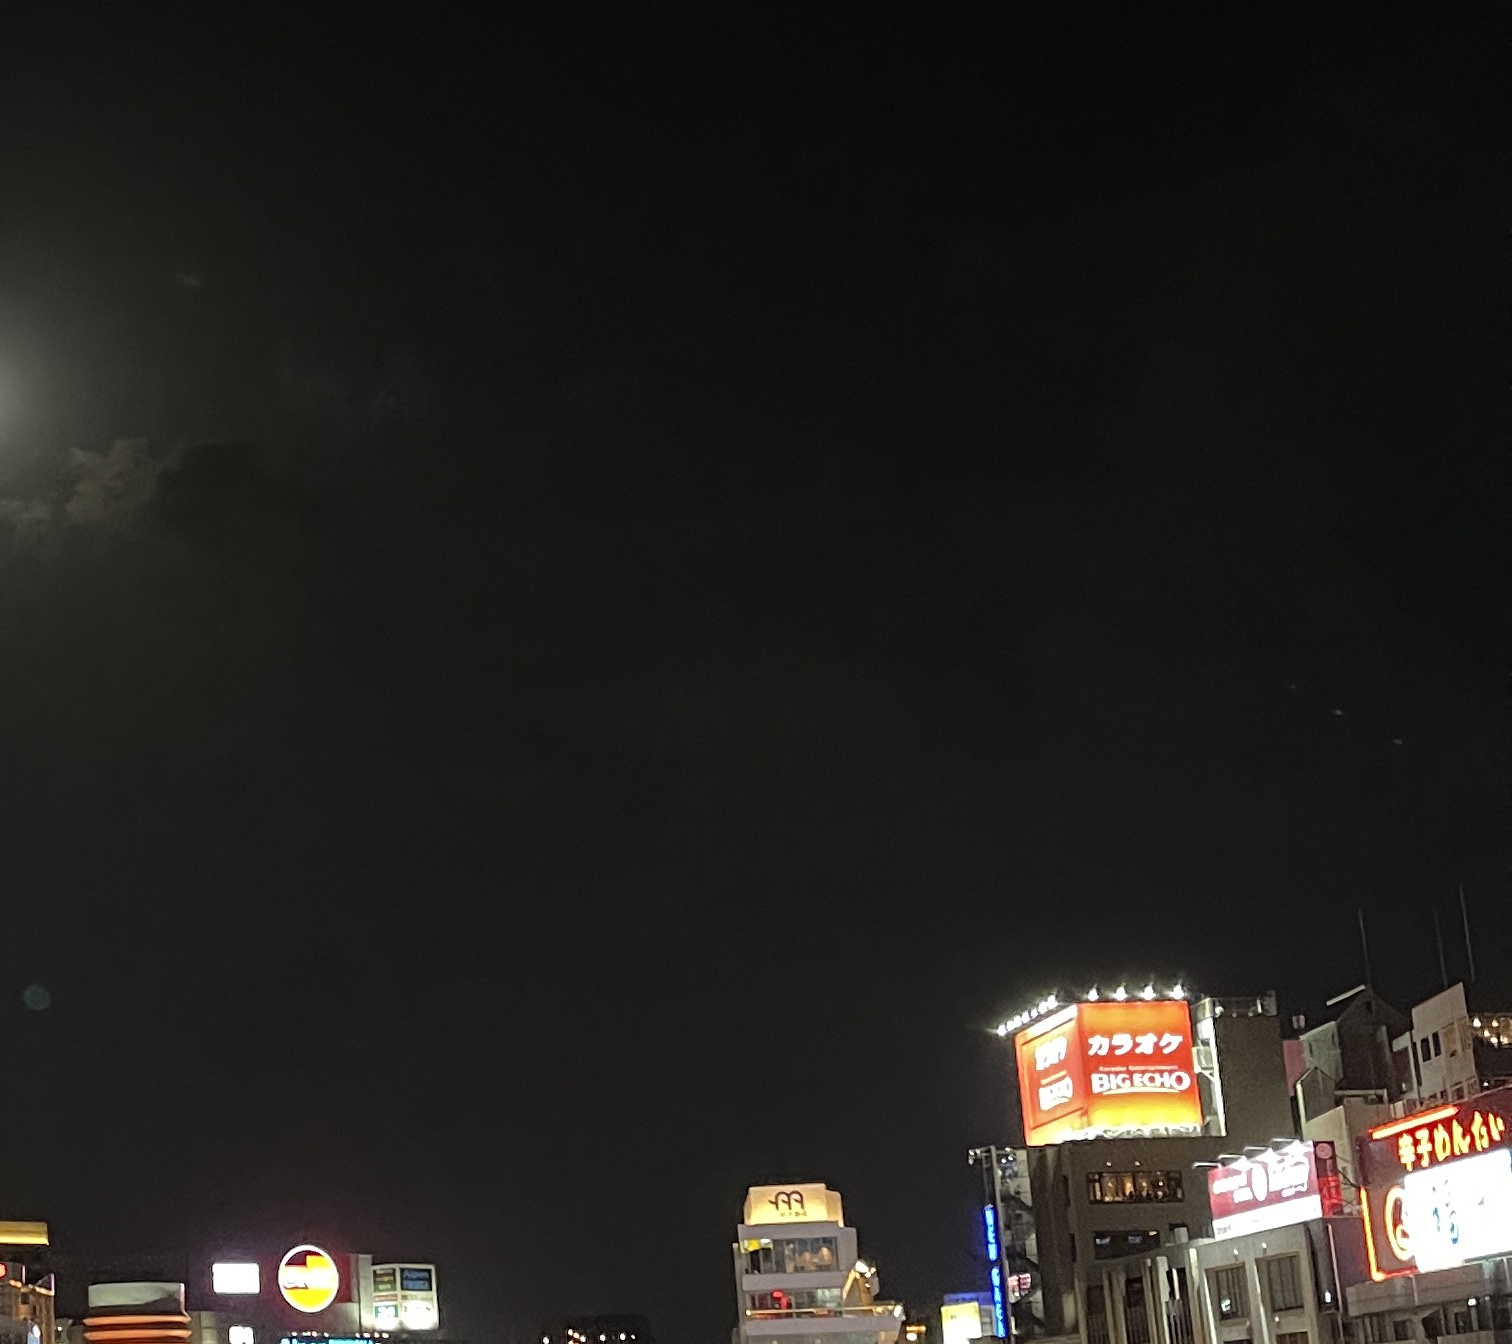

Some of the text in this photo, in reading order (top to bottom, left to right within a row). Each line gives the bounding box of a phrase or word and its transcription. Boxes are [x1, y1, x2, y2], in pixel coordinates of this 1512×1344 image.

[1088, 1033, 1183, 1056] カラオケ
[1091, 1073, 1131, 1094] BIG
[1132, 1071, 1191, 1091] ECHO
